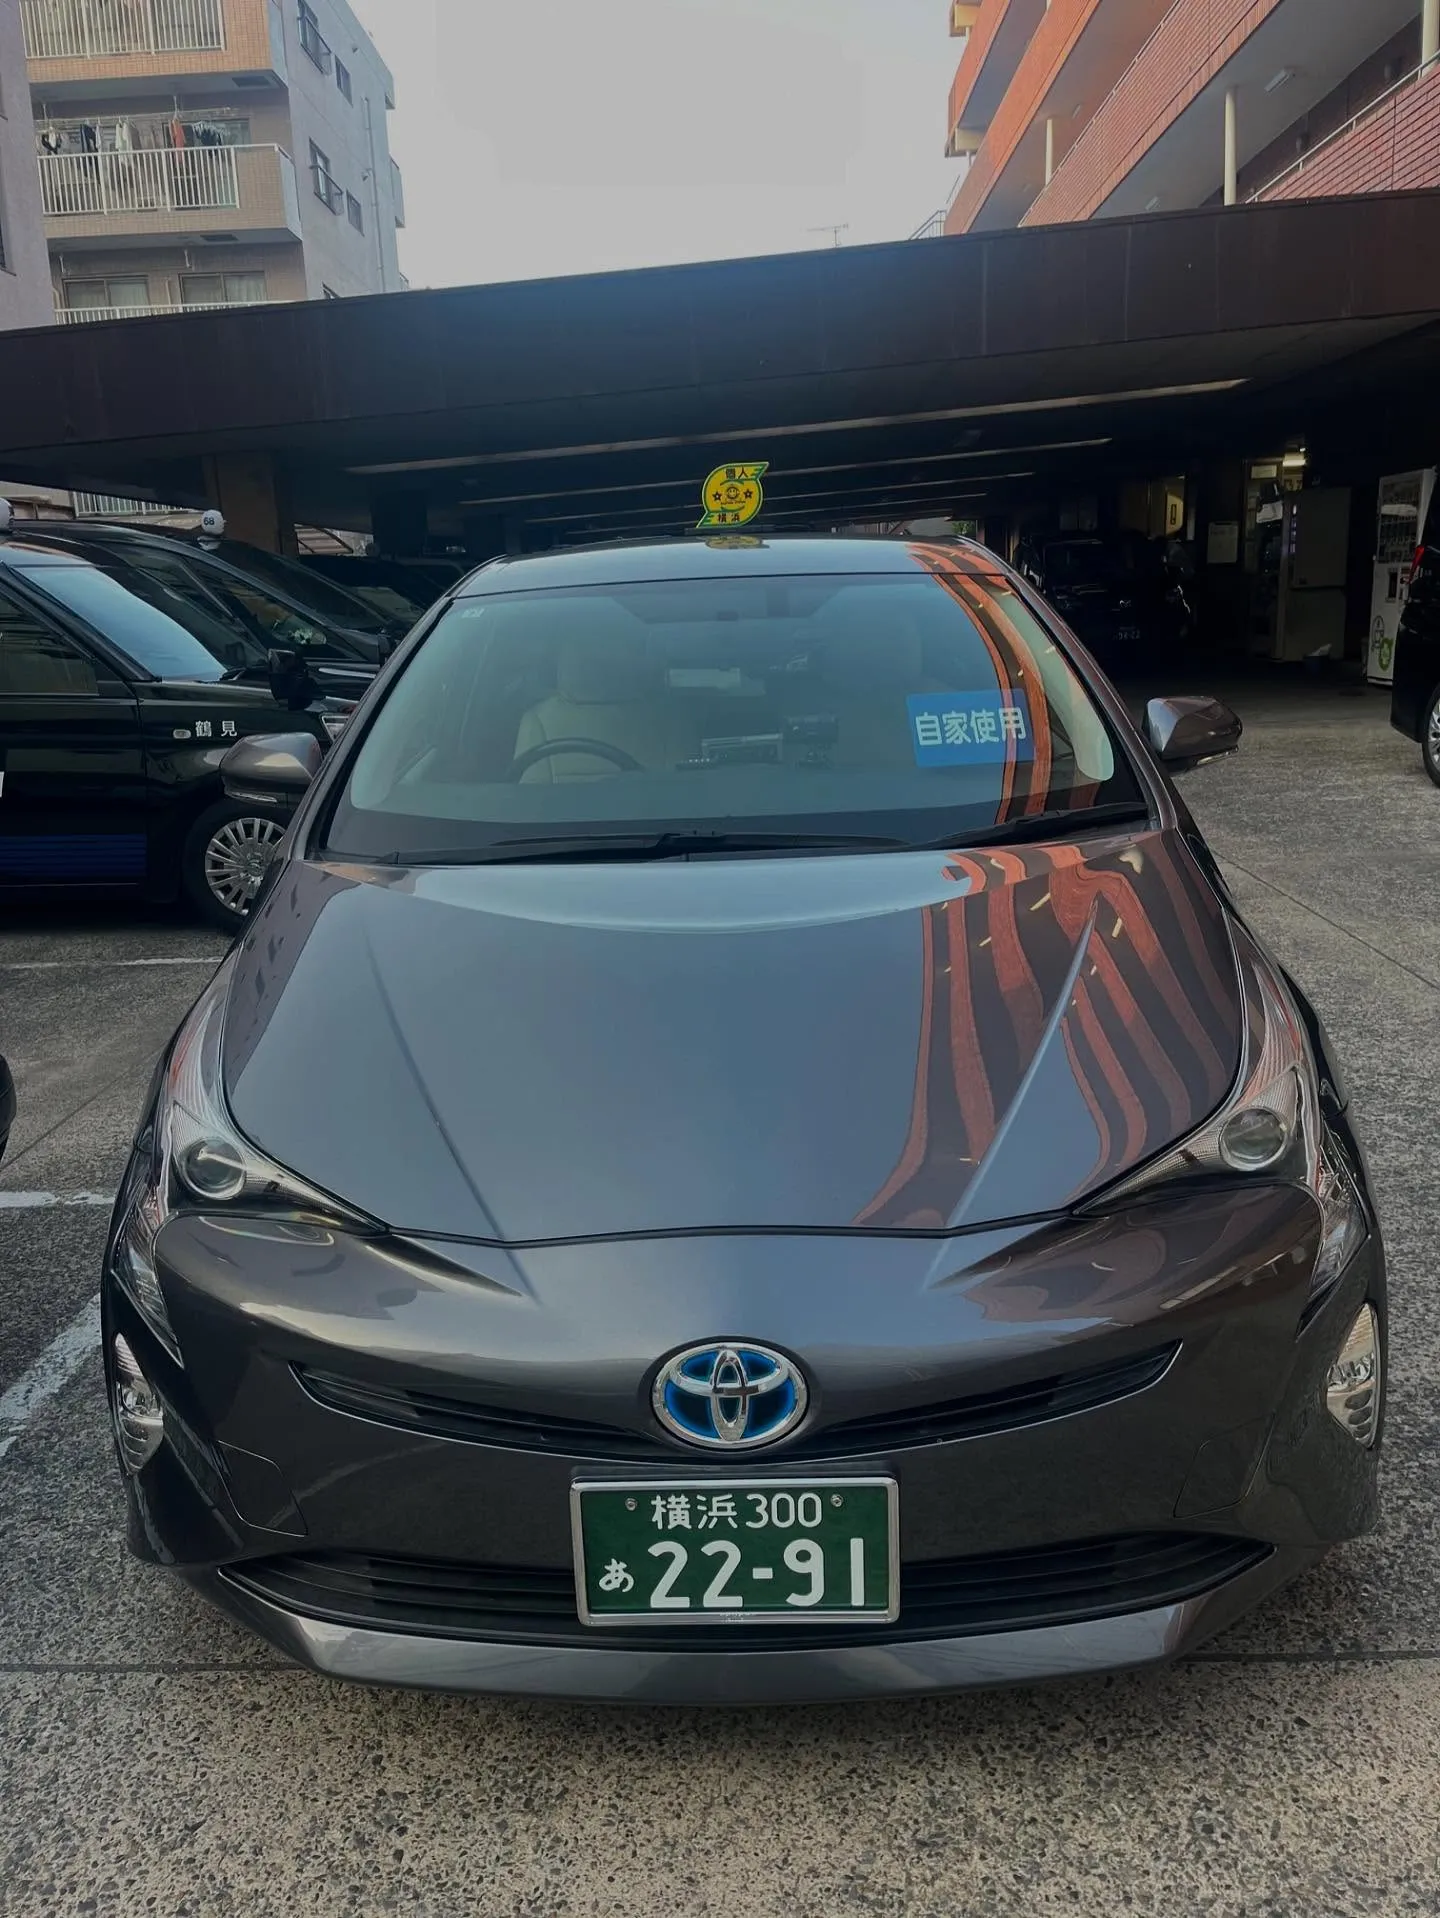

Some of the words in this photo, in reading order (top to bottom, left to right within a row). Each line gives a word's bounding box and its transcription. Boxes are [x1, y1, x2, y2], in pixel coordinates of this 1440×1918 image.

[195, 720, 238, 737] 鶴見
[915, 707, 1026, 746] 自家使用
[599, 1558, 635, 1592] あ
[647, 1537, 865, 1608] 22-91
